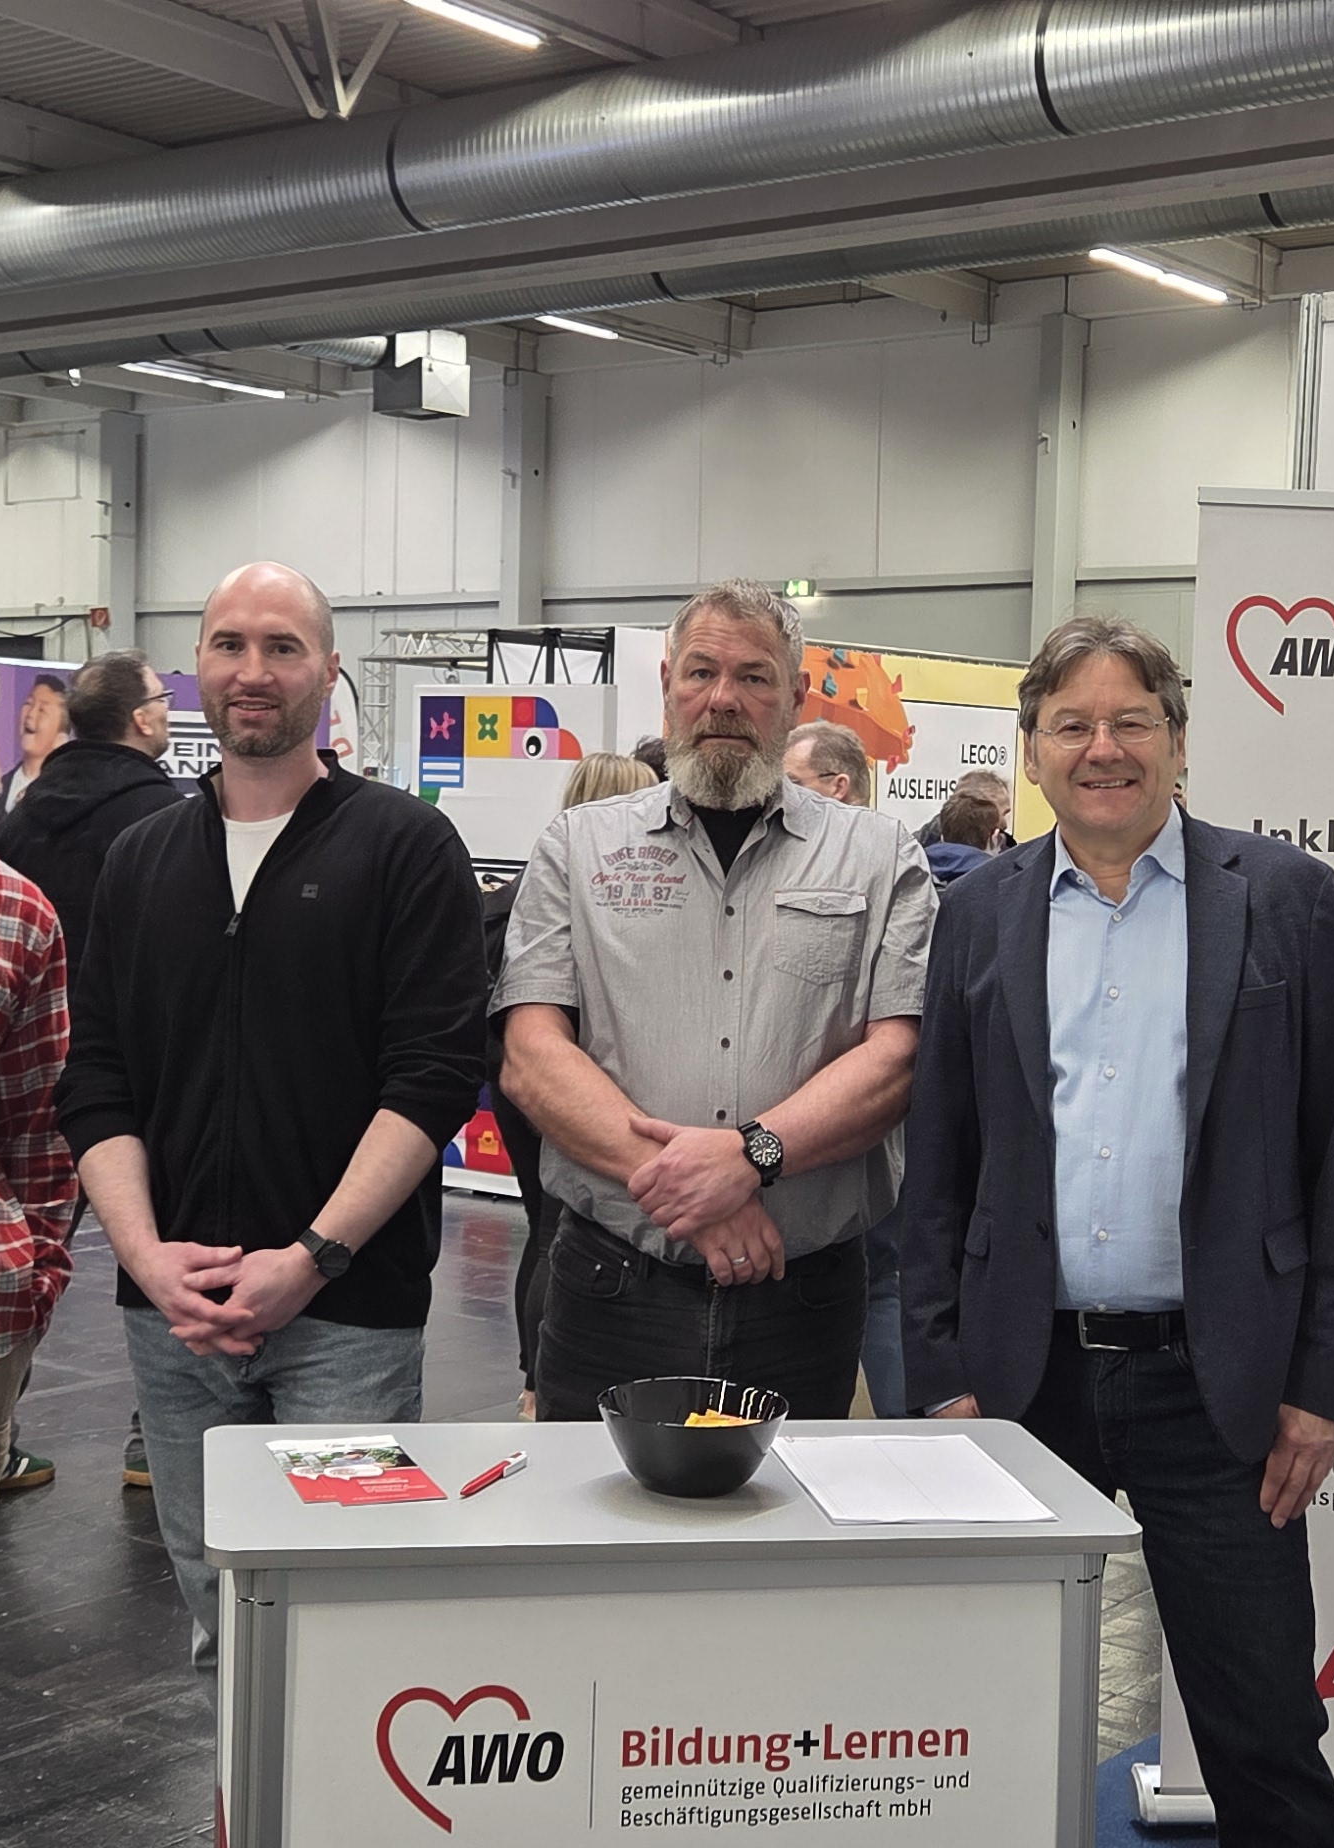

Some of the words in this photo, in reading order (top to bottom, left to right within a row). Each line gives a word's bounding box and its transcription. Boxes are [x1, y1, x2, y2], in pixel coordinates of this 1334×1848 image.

[887, 778, 957, 800] AUSLEIHS
[605, 884, 624, 900] 19
[652, 886, 672, 901] 87
[426, 1731, 565, 1787] AWO
[621, 1723, 970, 1773] Bildung+Lernen
[621, 1777, 766, 1804] gemeinnützige
[773, 1773, 926, 1798] Qualifizierungs-
[934, 1771, 970, 1790] und
[620, 1800, 882, 1828] Beschäftigungsgesellschaft
[889, 1798, 931, 1817] mbH
